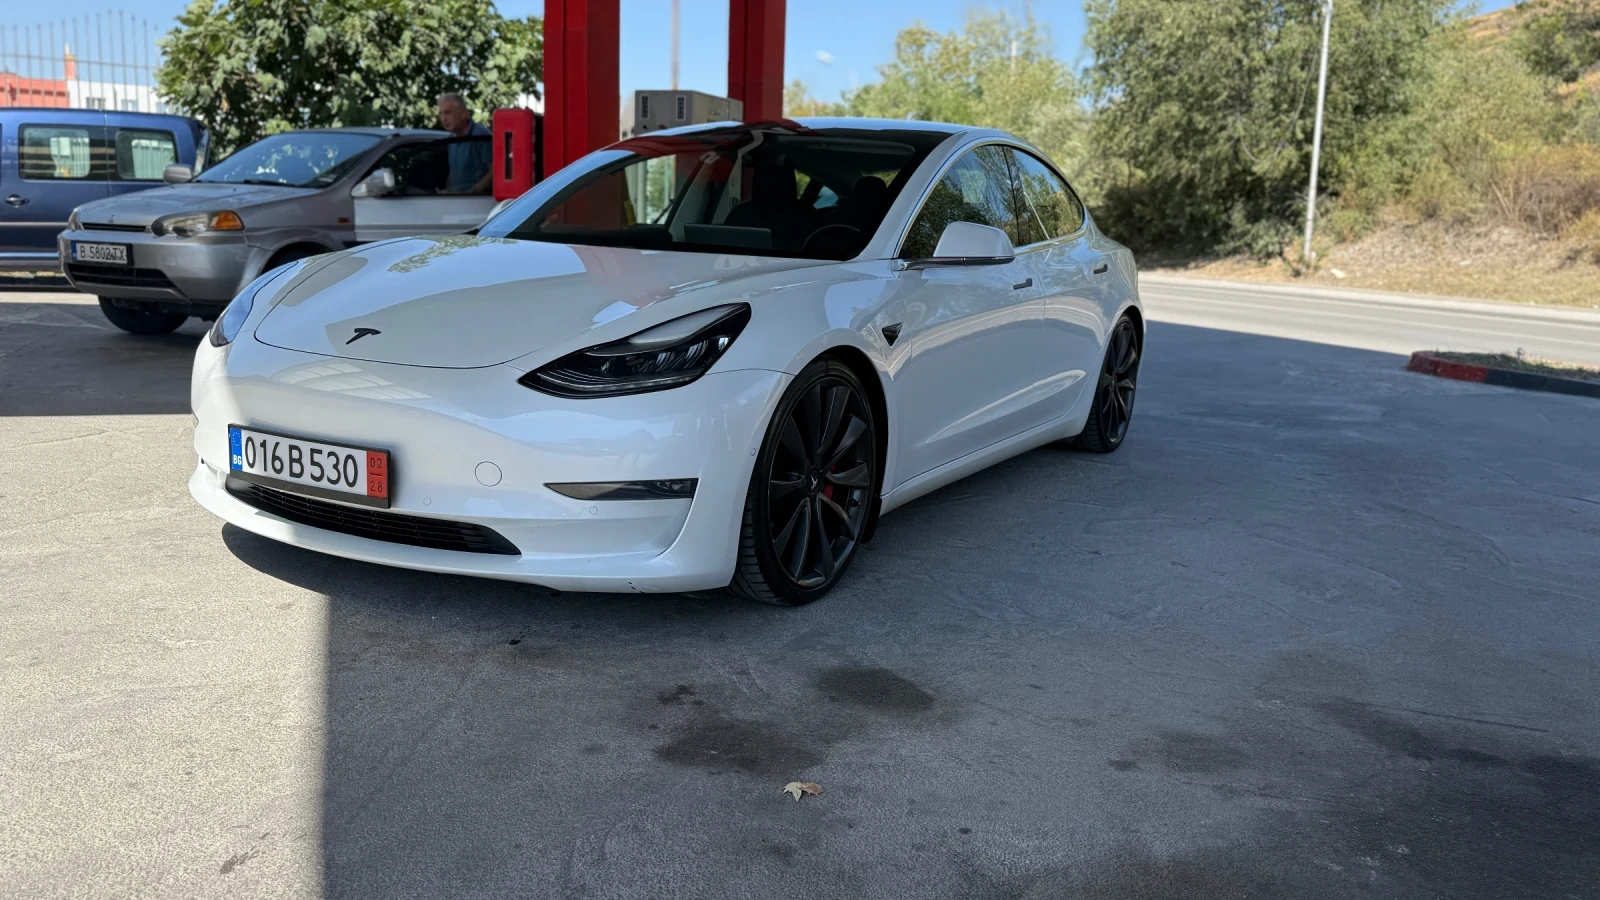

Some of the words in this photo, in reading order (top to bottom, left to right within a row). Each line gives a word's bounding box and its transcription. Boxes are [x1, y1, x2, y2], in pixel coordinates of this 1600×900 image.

[233, 454, 242, 465] BG
[244, 436, 358, 488] 016B530
[370, 457, 383, 469] 02
[370, 480, 383, 493] 28
